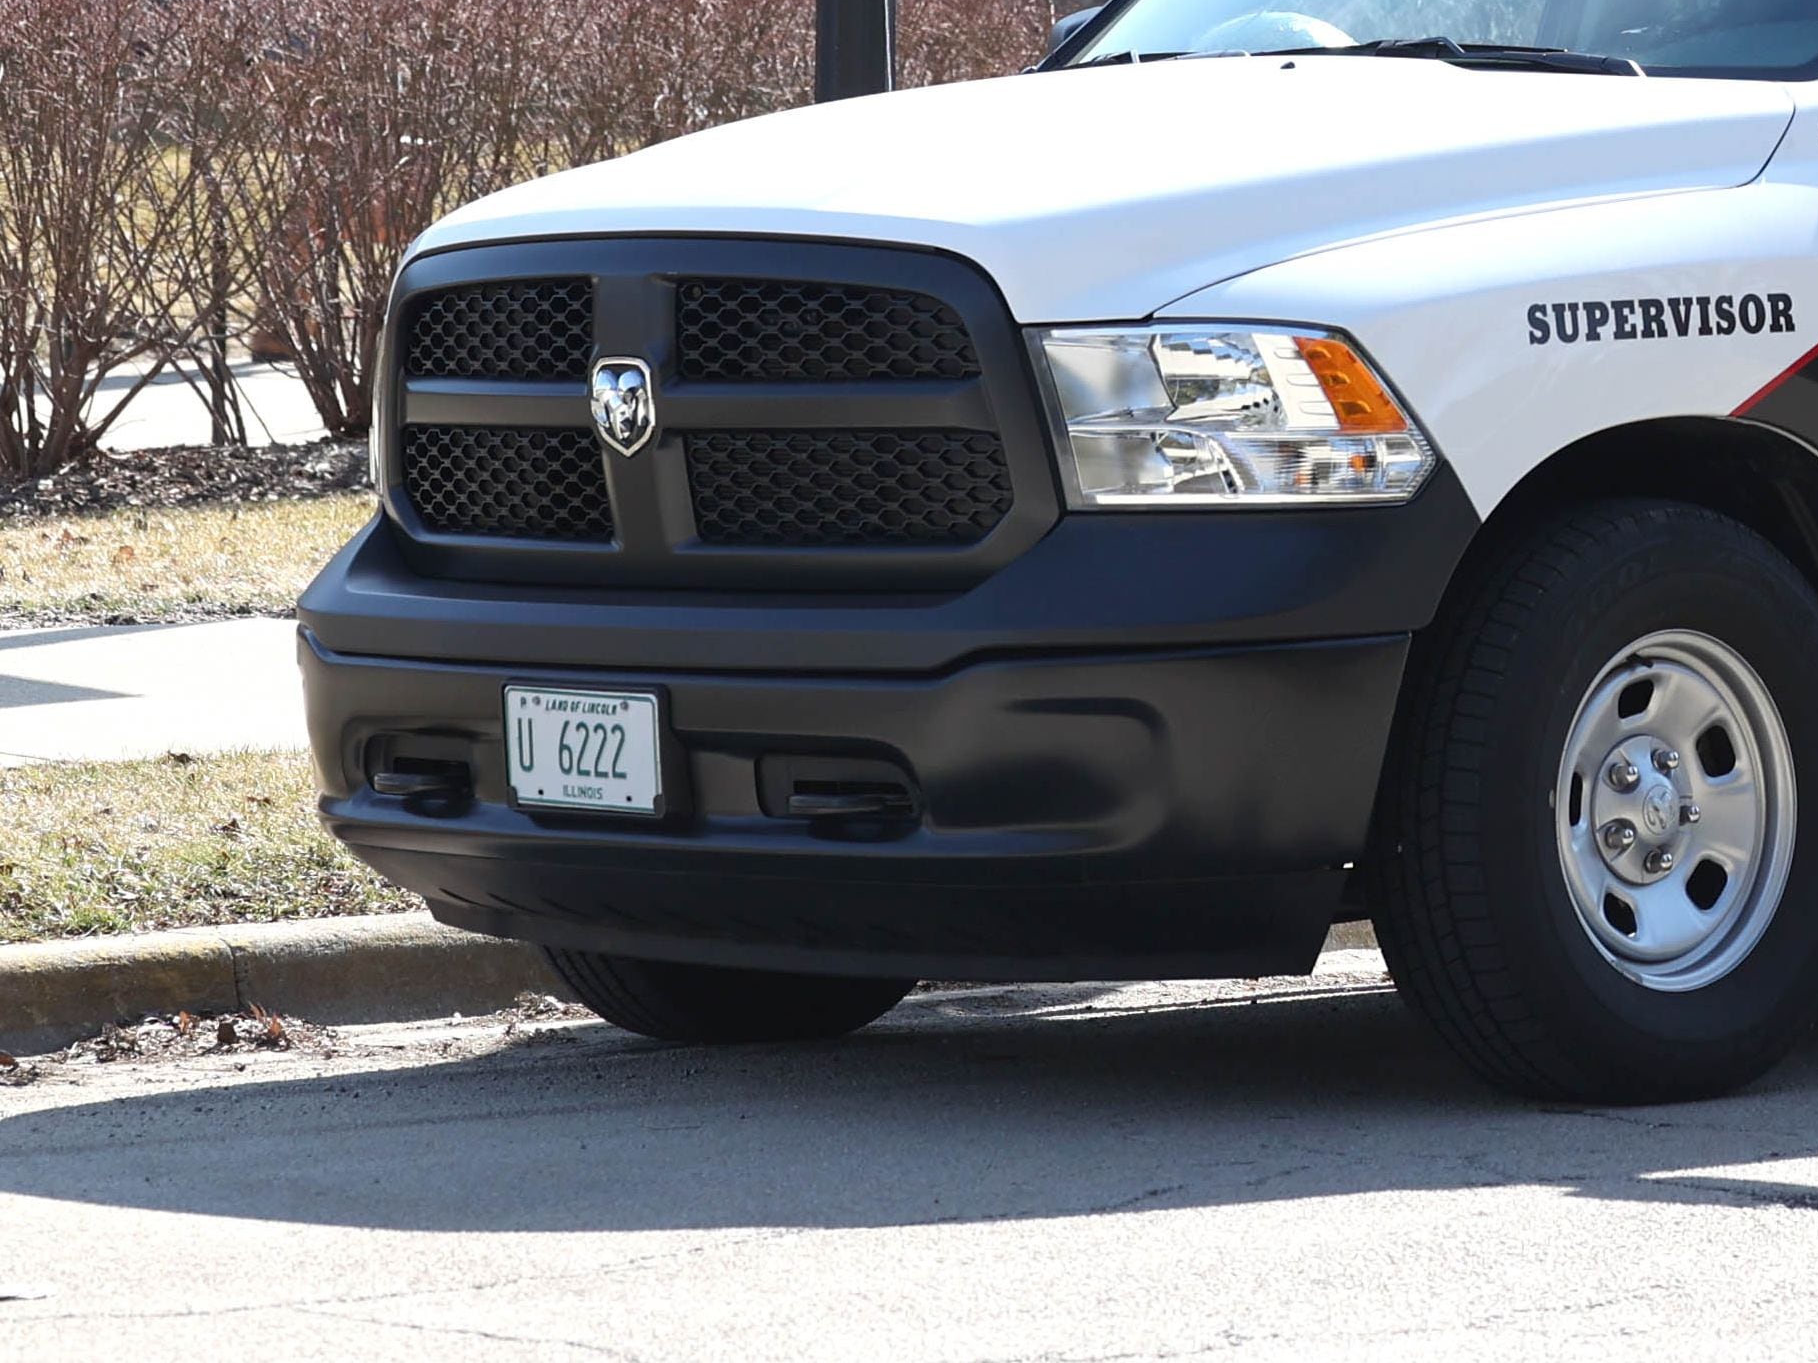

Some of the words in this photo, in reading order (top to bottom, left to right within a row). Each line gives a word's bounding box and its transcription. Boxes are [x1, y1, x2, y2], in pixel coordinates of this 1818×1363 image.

[1526, 292, 1796, 344] SUPERVISOR
[545, 699, 568, 712] LAND
[570, 700, 581, 713] OF
[582, 701, 618, 716] LINCOLN
[518, 717, 534, 772] U
[559, 720, 627, 779] 6222
[562, 784, 604, 800] ILLINOIS
